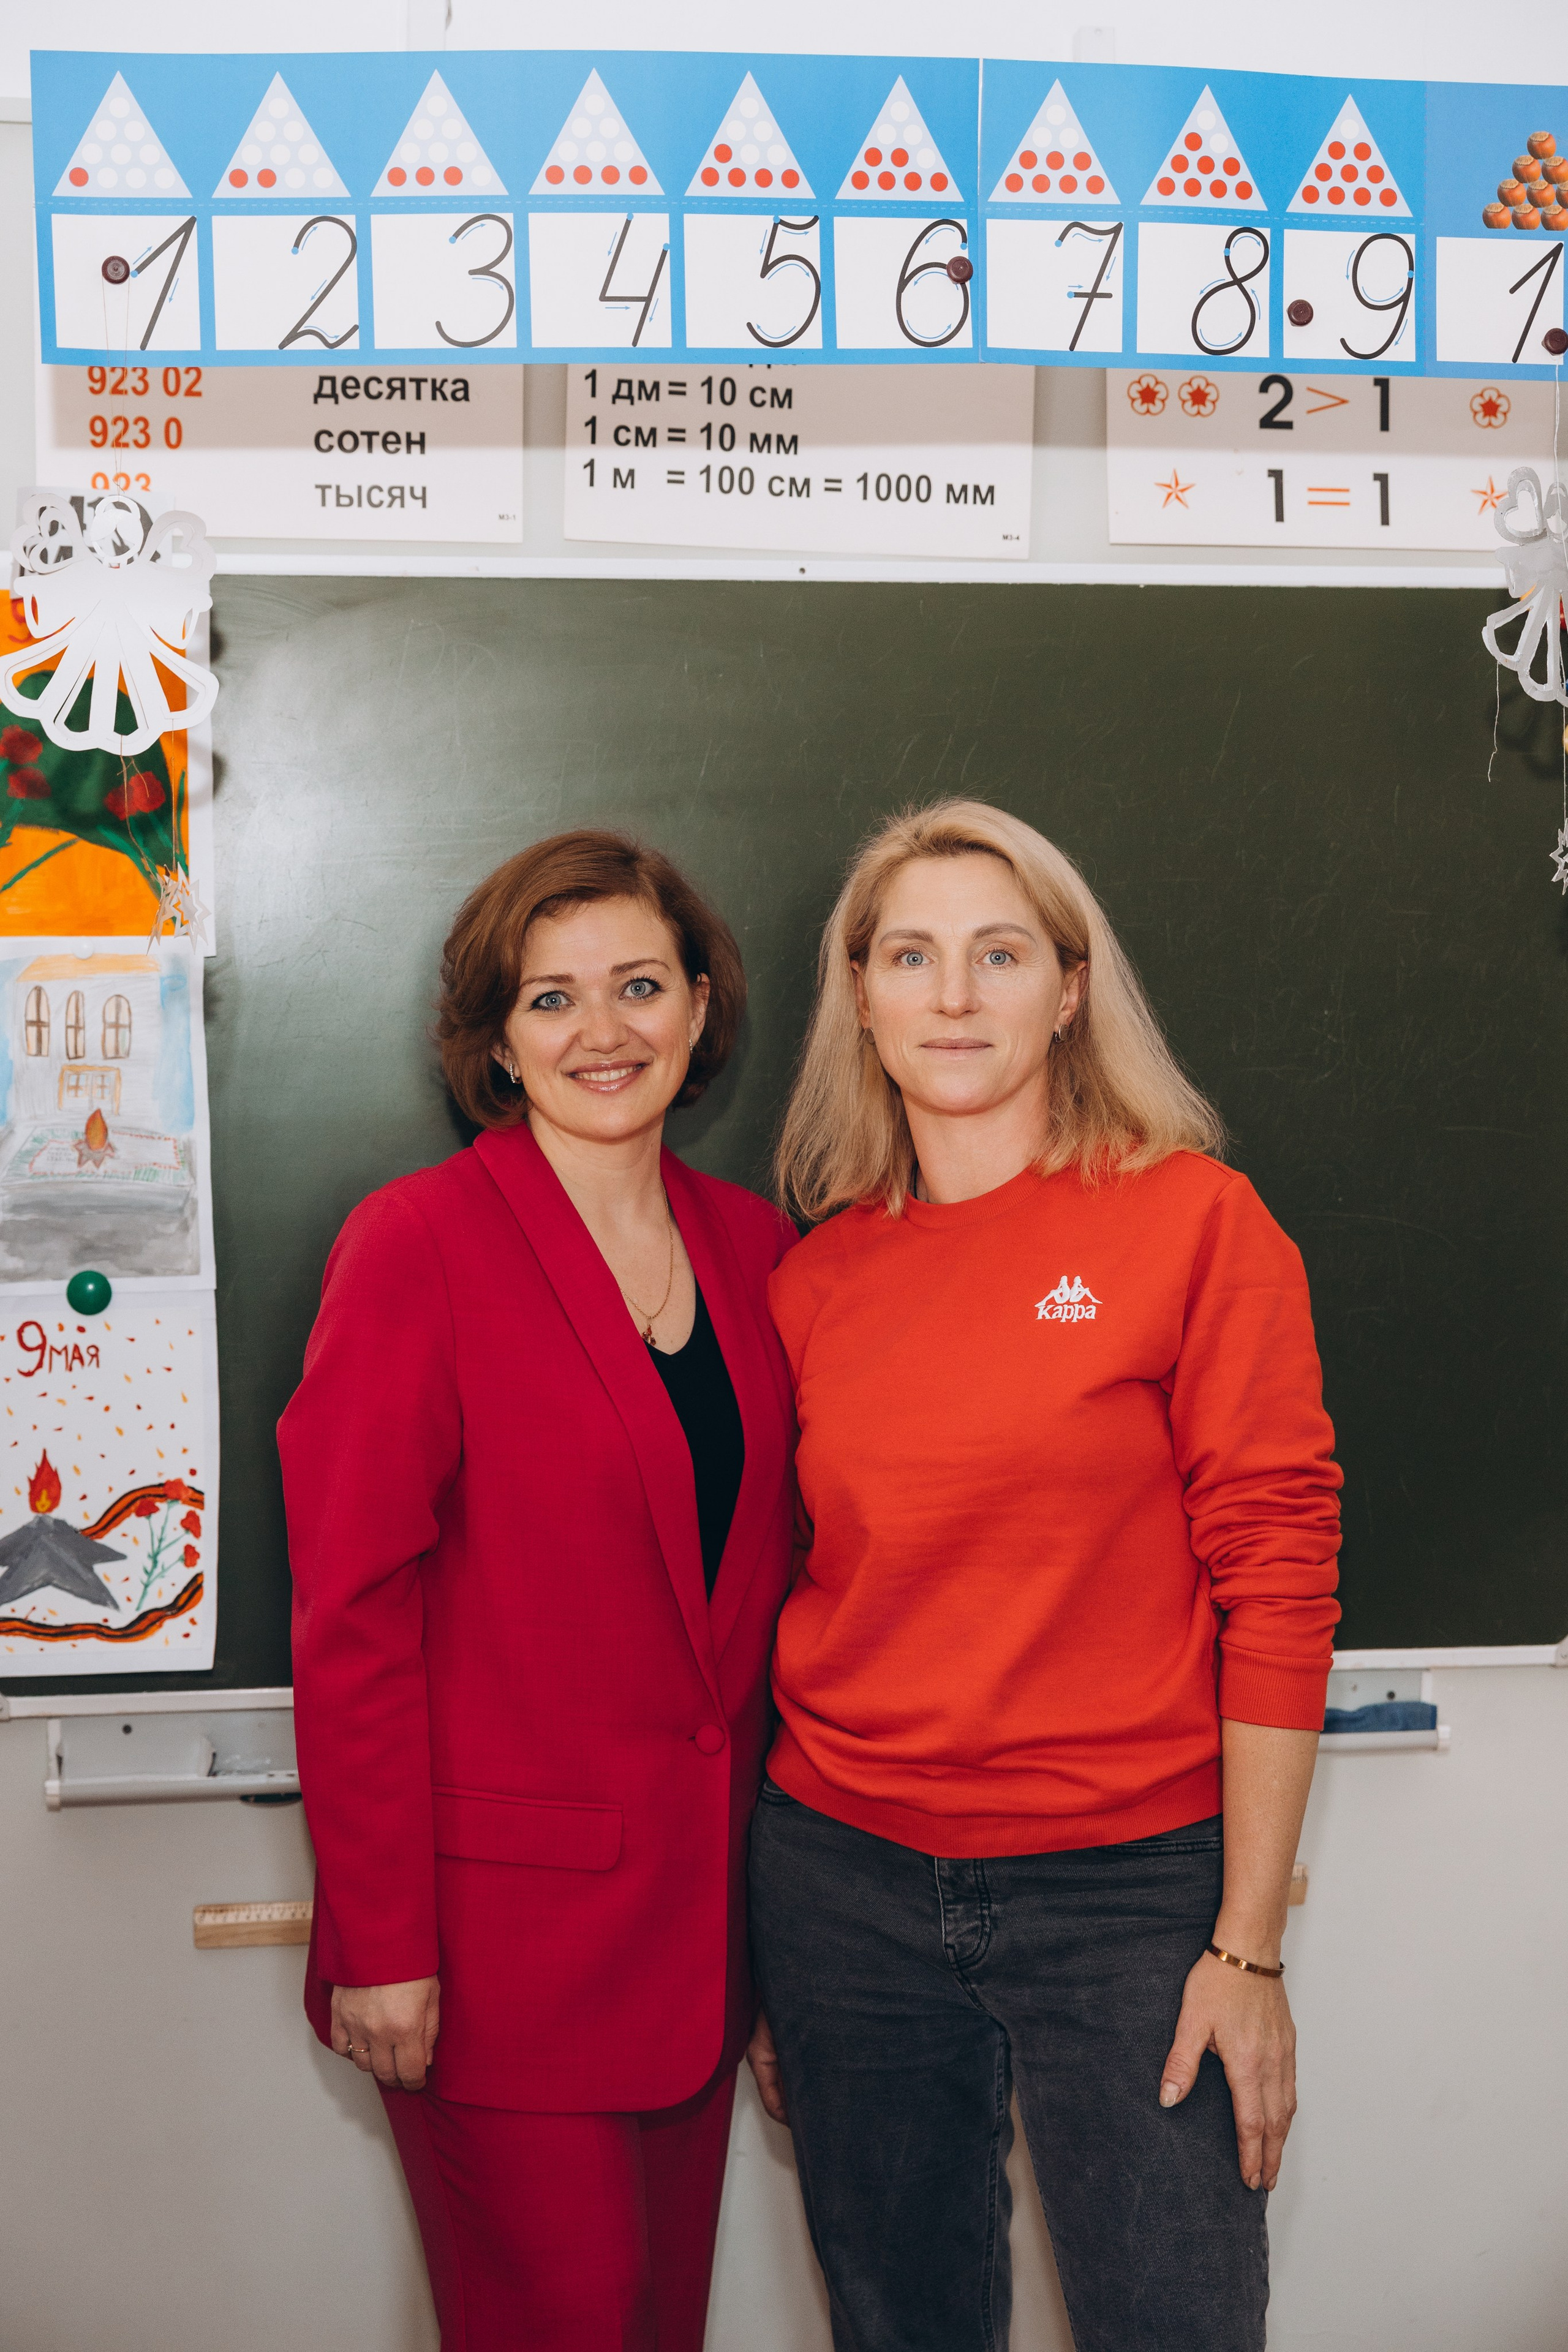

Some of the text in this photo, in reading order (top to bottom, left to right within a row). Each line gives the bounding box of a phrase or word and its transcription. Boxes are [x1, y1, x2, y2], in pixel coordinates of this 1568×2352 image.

[131, 216, 197, 350] 1
[279, 217, 360, 350] 2
[436, 215, 514, 348] 3
[600, 214, 668, 347] 4
[747, 215, 821, 348] 5
[896, 219, 970, 347] 6
[1055, 222, 1123, 352] 7
[1193, 228, 1270, 356] 8
[1341, 235, 1414, 360] 9
[88, 366, 203, 398] 923 02
[314, 375, 471, 405] десятка
[585, 369, 598, 399] 1
[612, 379, 661, 407] дм
[701, 376, 737, 407] 10
[750, 386, 793, 410] см
[1259, 374, 1294, 431] 2
[1373, 377, 1390, 433] 1
[89, 415, 183, 450] 923 0
[314, 429, 426, 455] сотен
[585, 416, 598, 445] 1
[614, 425, 658, 448] см
[700, 422, 737, 453] 10
[750, 432, 799, 456] мм
[316, 486, 427, 509] тысяч
[584, 459, 595, 488] 1
[614, 469, 635, 489] м
[700, 466, 755, 496] 100
[769, 477, 811, 499] см
[858, 473, 932, 503] 1000
[947, 484, 995, 506] мм
[1268, 470, 1285, 523] 1
[1374, 473, 1390, 527] 1
[1035, 1303, 1096, 1322] Kappa
[17, 1321, 47, 1378] 9
